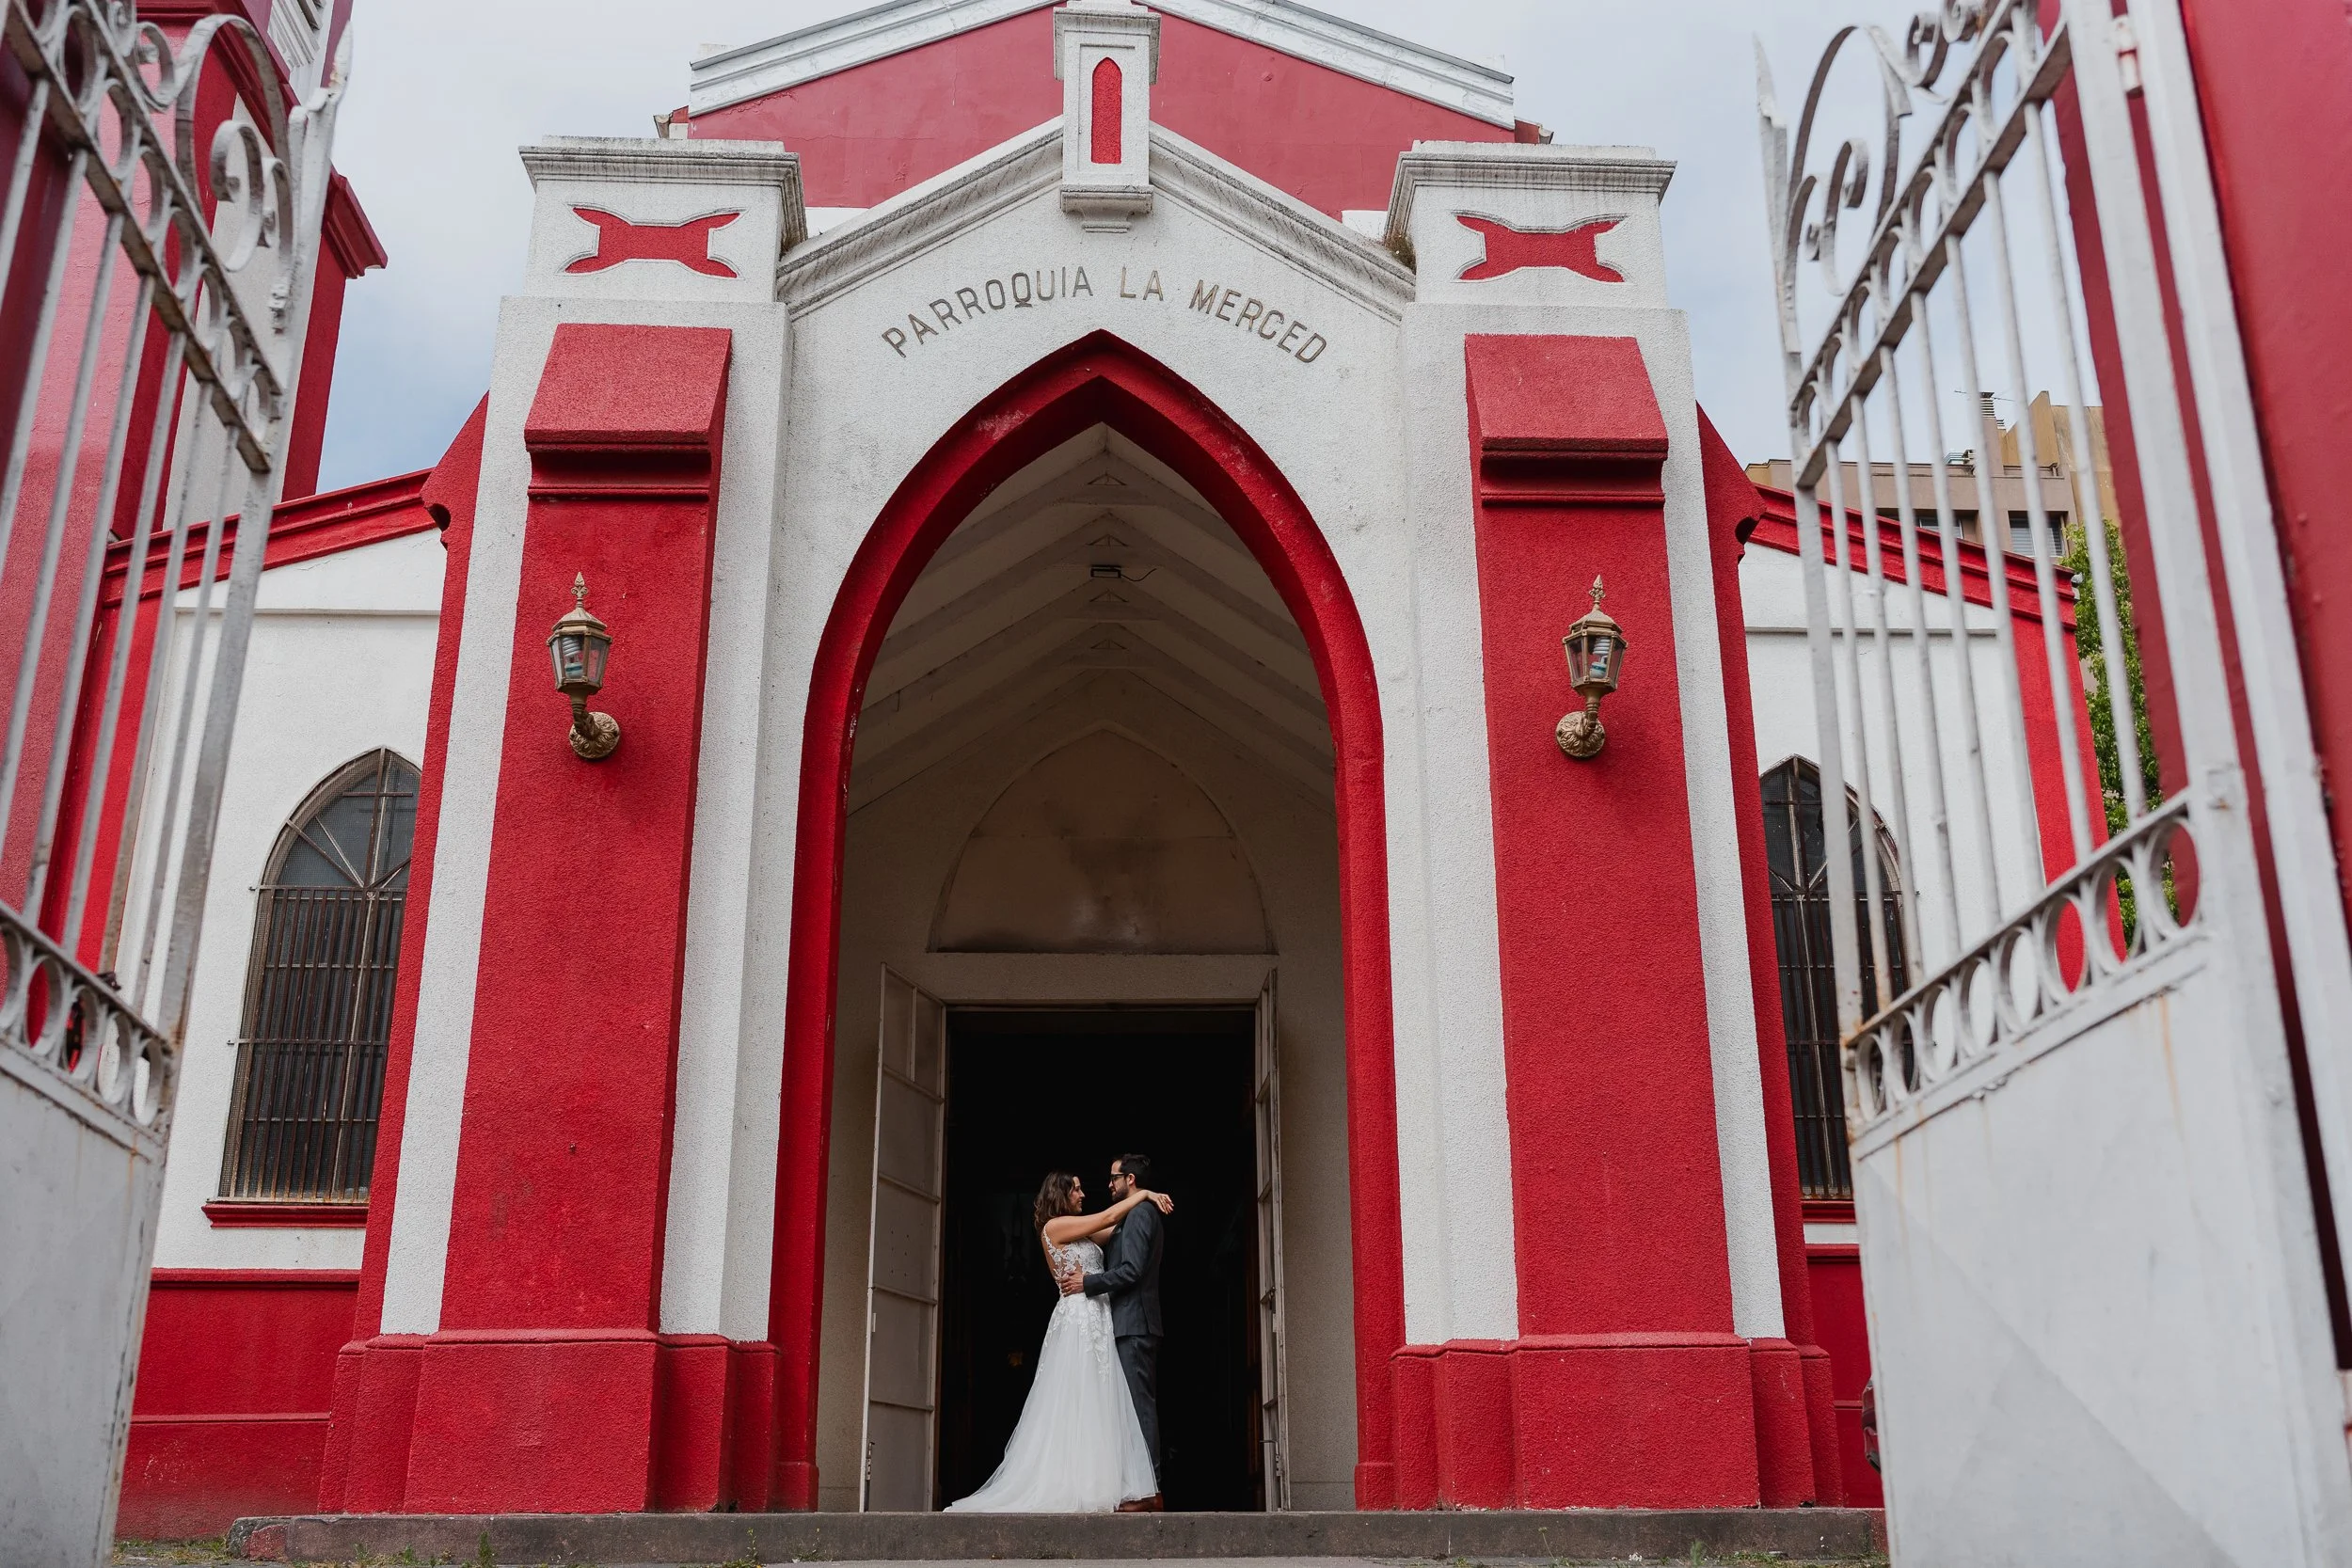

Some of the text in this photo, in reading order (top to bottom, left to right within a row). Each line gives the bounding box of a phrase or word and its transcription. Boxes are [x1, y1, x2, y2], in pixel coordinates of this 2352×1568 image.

[882, 265, 1327, 364] PARROQUIA LA MERCED
